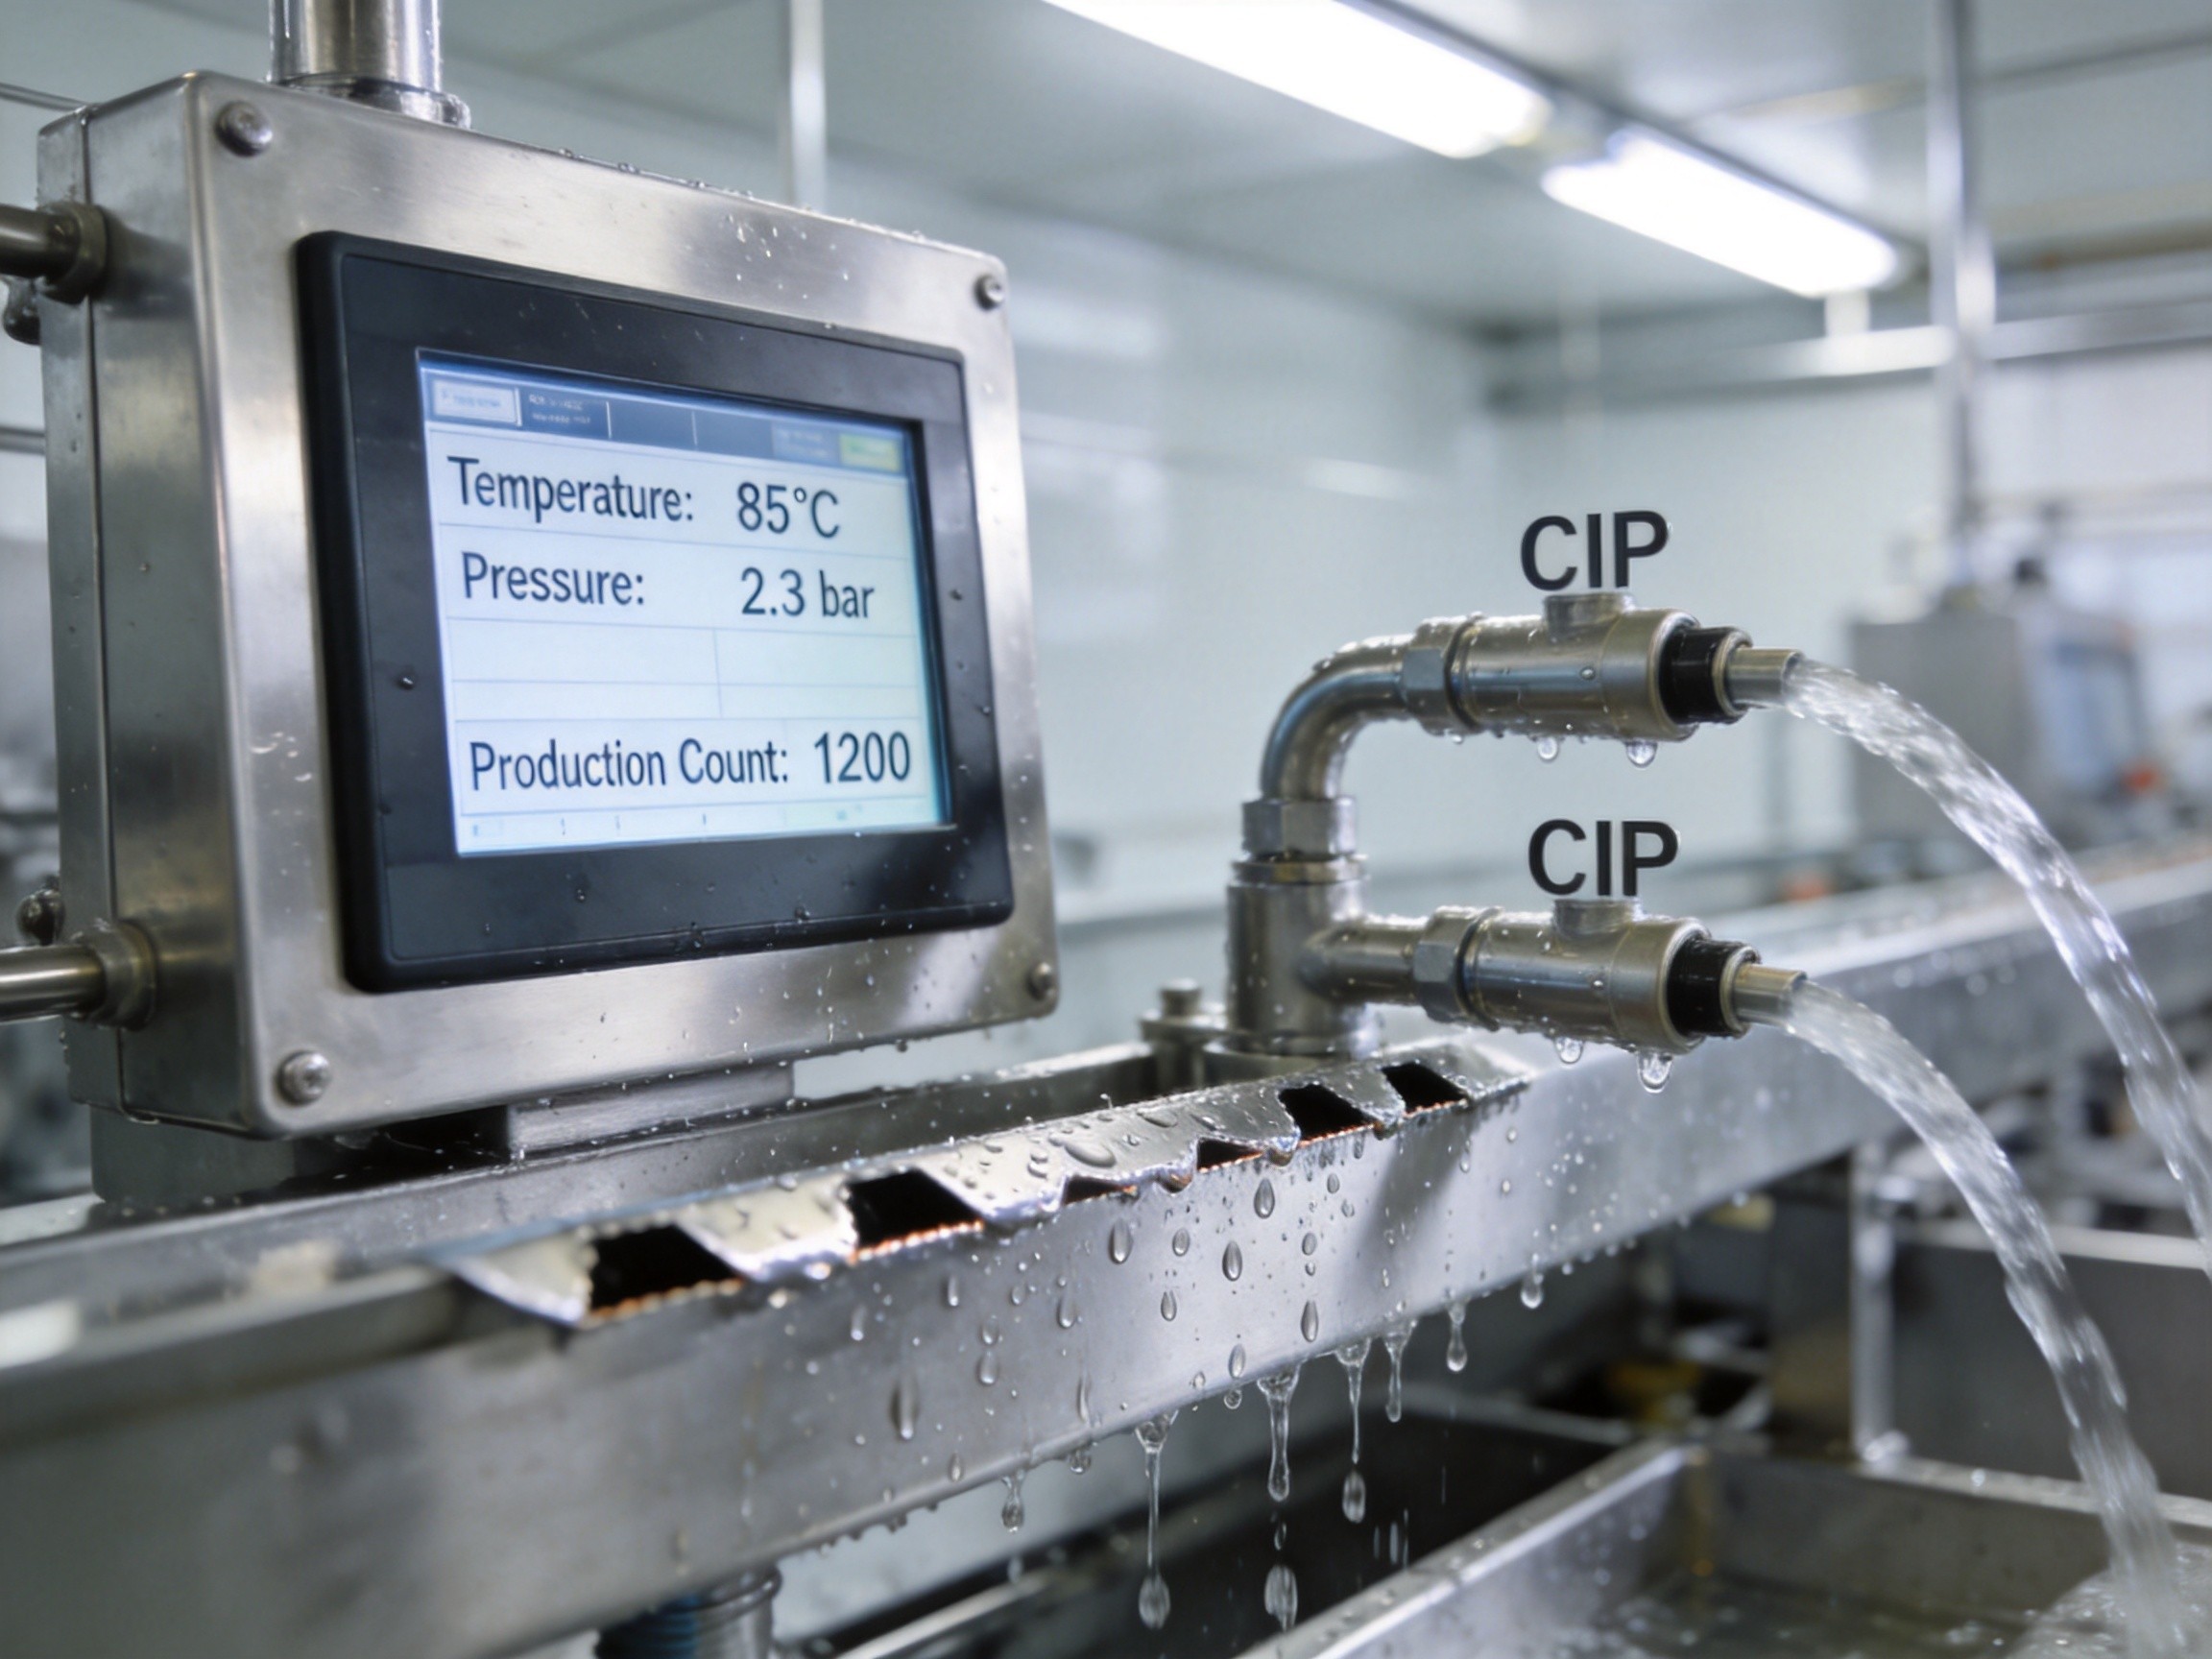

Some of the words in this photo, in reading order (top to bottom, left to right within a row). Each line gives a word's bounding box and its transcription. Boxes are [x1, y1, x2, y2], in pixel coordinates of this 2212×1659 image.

[447, 455, 693, 523] Temperature:
[736, 481, 841, 539] 85°C
[461, 551, 645, 606] Pressure:
[740, 566, 805, 616] 2.3
[820, 568, 875, 619] bar
[1520, 510, 1670, 591] CIP
[469, 738, 666, 791] Production
[679, 737, 788, 785] Count:
[813, 731, 911, 785] 1200
[1527, 818, 1679, 898] CIP
